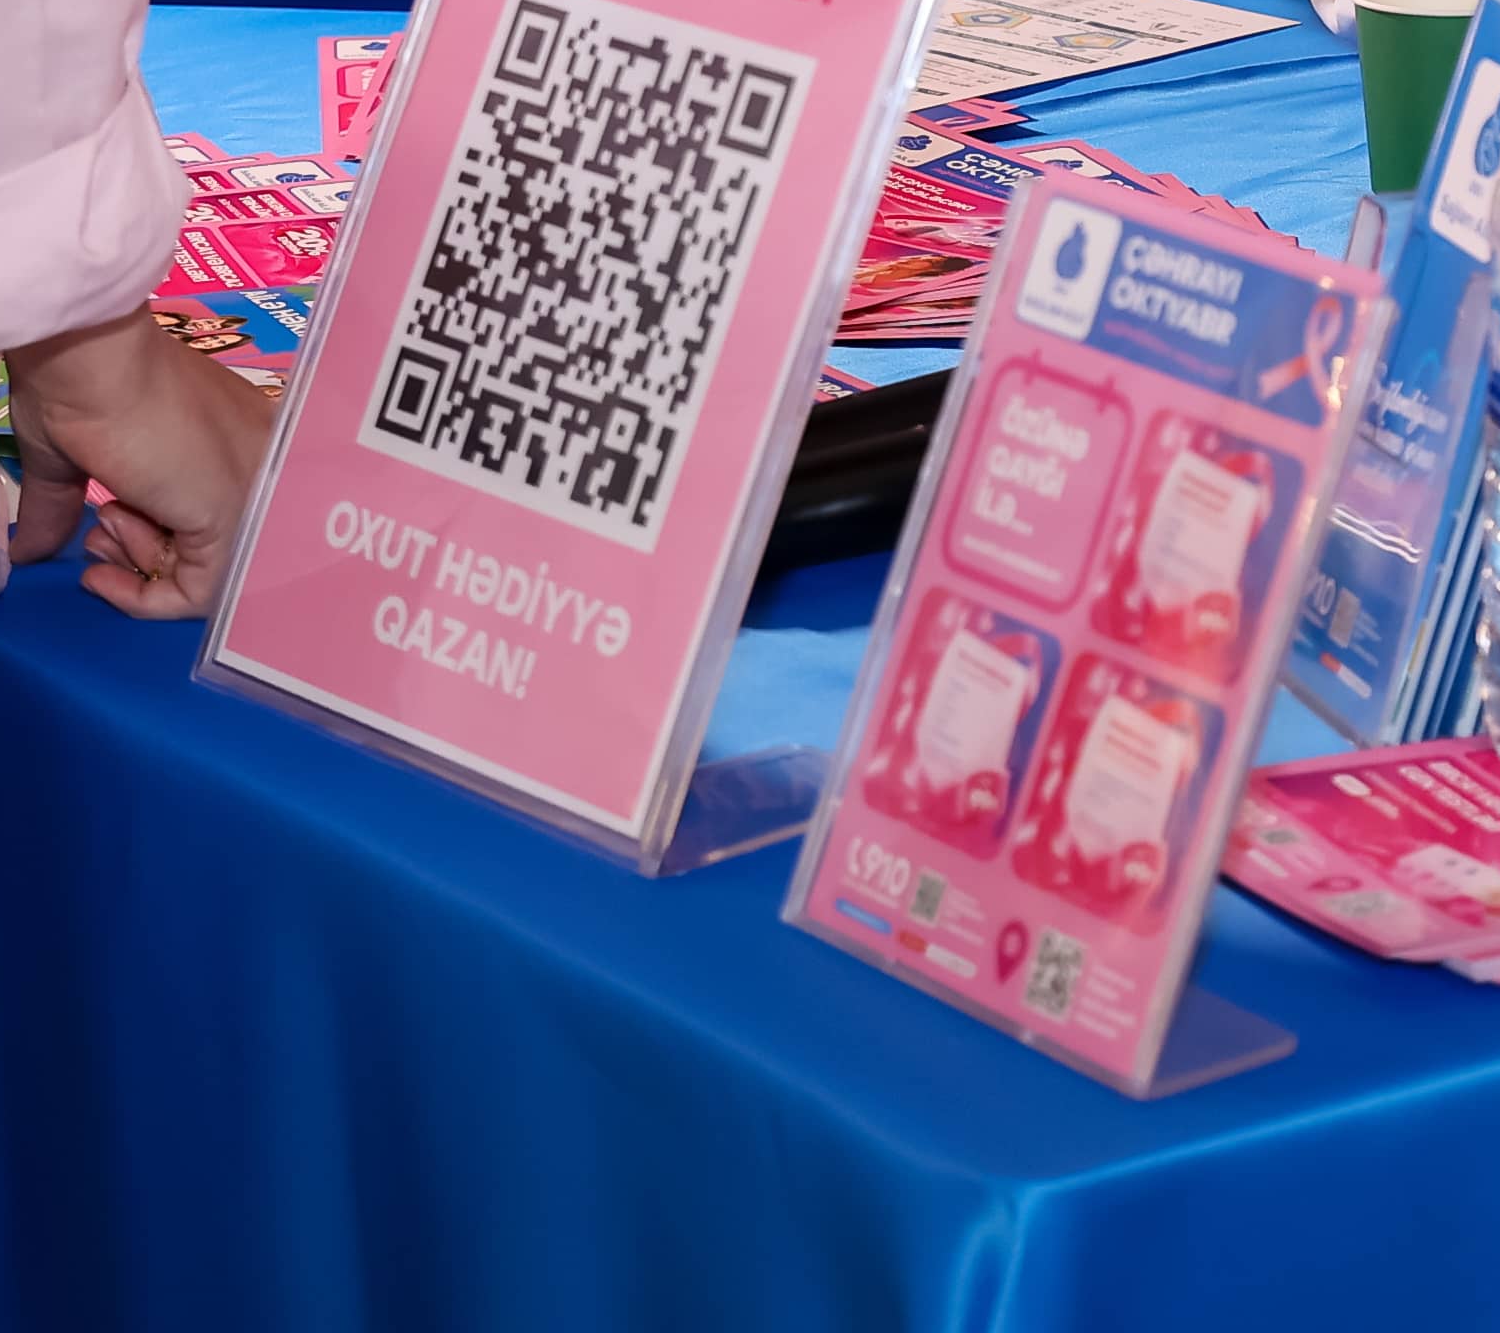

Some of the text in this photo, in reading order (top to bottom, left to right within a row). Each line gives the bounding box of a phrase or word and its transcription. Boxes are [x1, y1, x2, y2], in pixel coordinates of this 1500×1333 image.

[963, 152, 1044, 185] ÇƏHR
[325, 500, 631, 657] OXUT HƏDİYYƏ
[373, 595, 538, 700] QAZAN!
